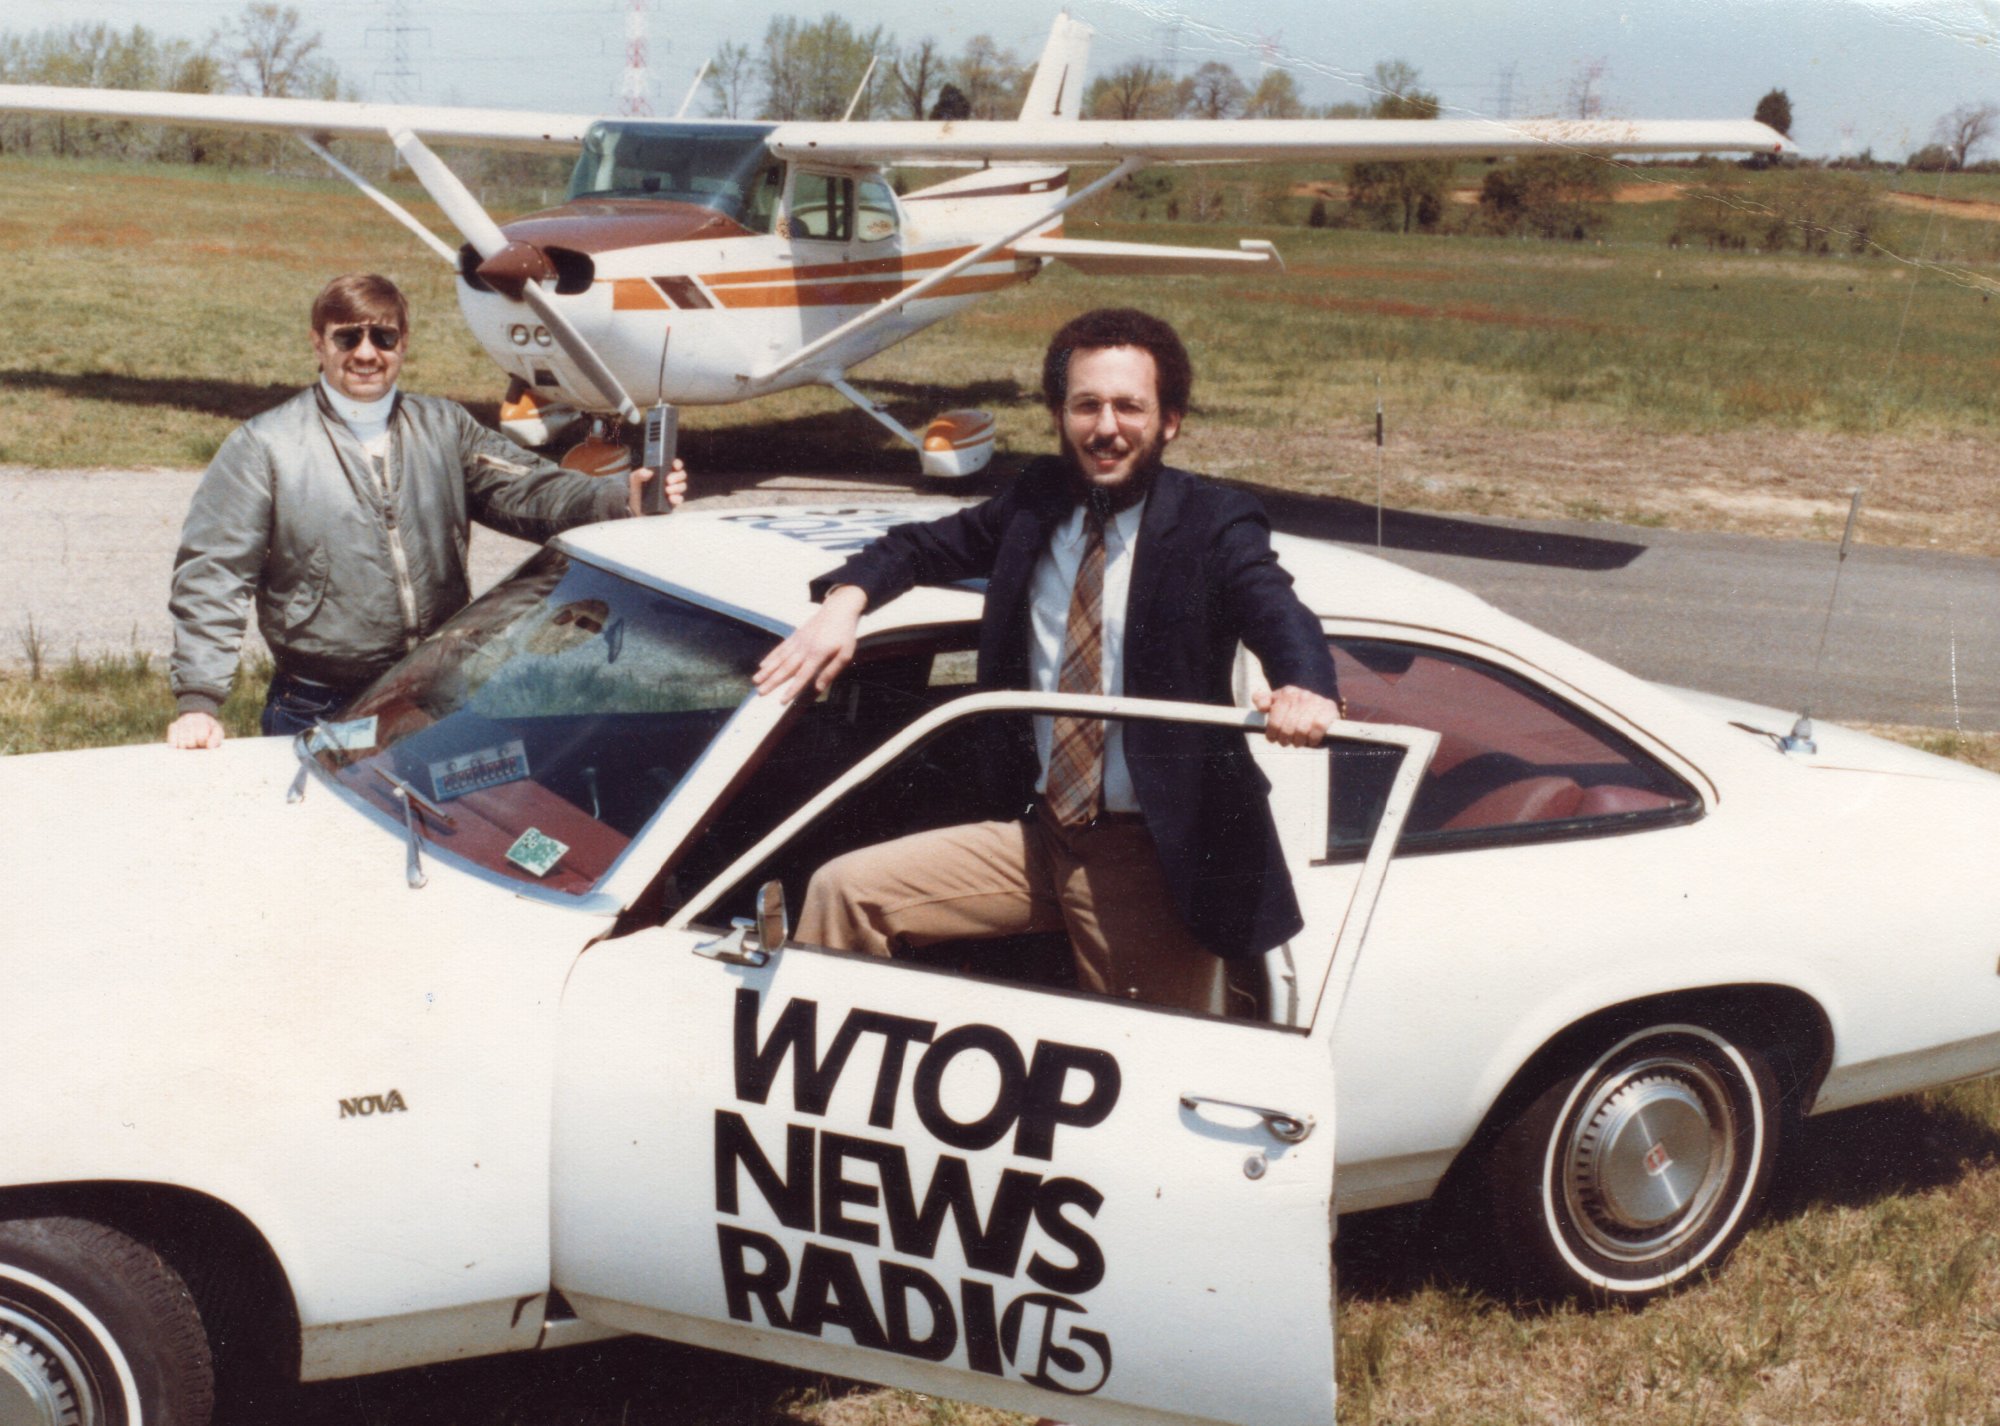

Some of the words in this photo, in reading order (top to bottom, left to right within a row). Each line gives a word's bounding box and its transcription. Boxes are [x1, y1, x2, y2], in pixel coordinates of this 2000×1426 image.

[338, 1089, 408, 1118] NOVA
[734, 987, 1121, 1161] WTOP
[715, 1109, 1105, 1294] NEWS
